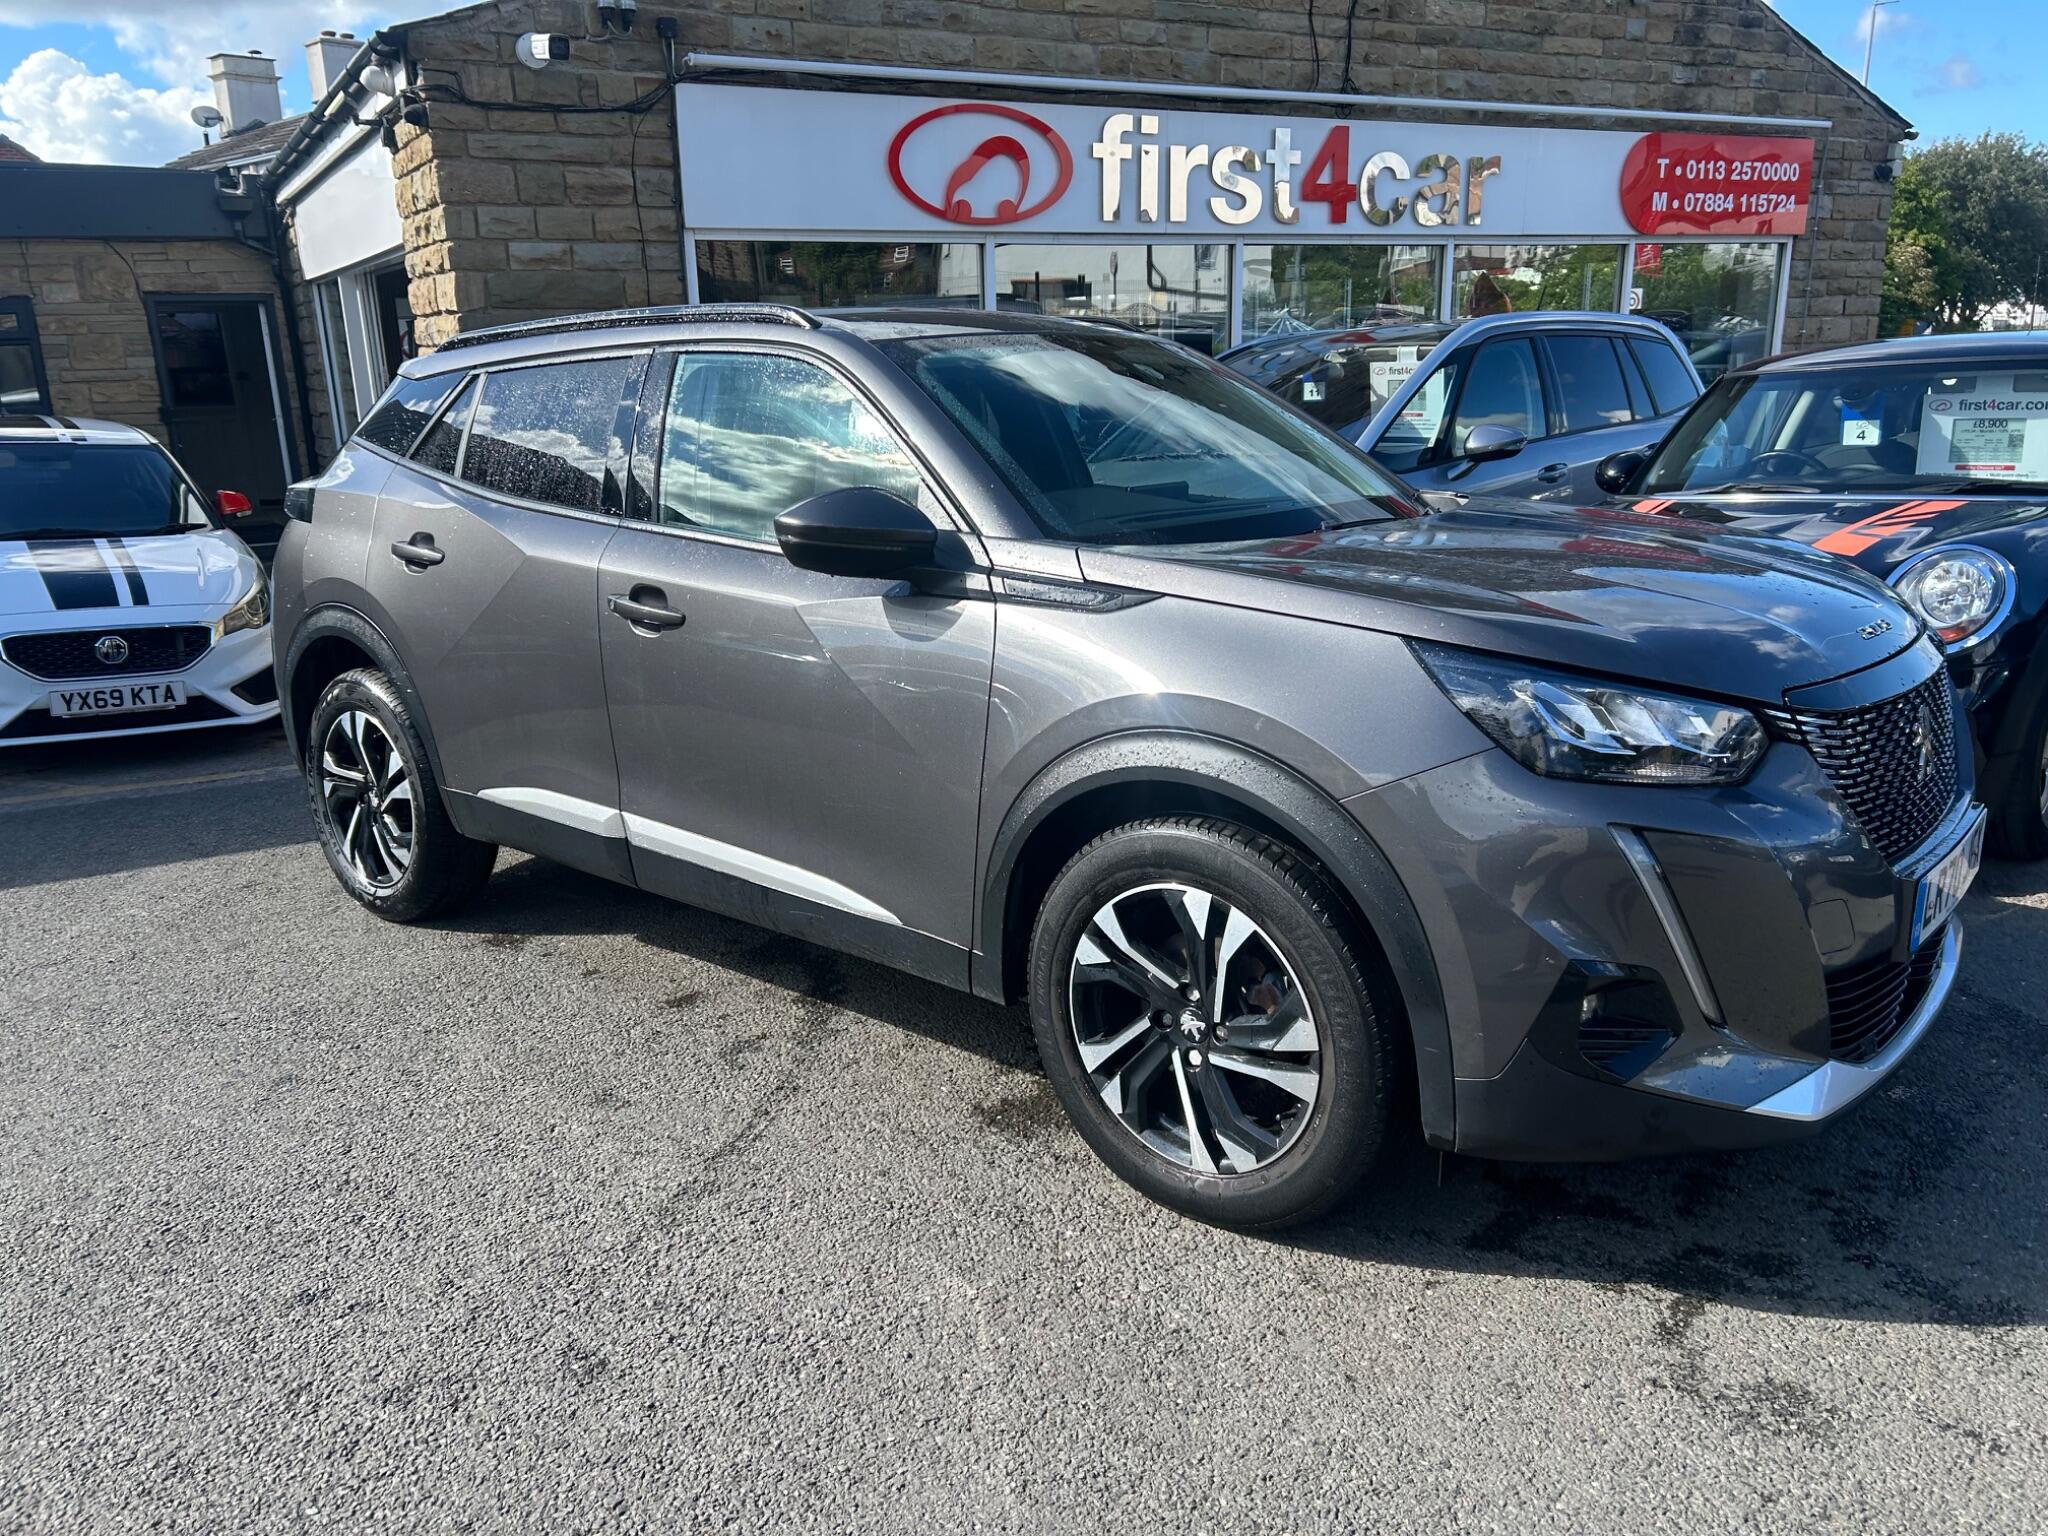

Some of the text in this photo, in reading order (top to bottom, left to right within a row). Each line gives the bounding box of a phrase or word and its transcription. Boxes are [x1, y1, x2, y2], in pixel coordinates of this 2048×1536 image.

[1092, 113, 1502, 227] first4car
[1657, 158, 1800, 182] T 0113 2570000
[1652, 191, 1796, 213] M 07884 115724
[1309, 388, 1320, 397] 11
[1856, 430, 1866, 441] 4
[1972, 419, 2009, 430] £8,900
[60, 683, 177, 712] YX69 KTA
